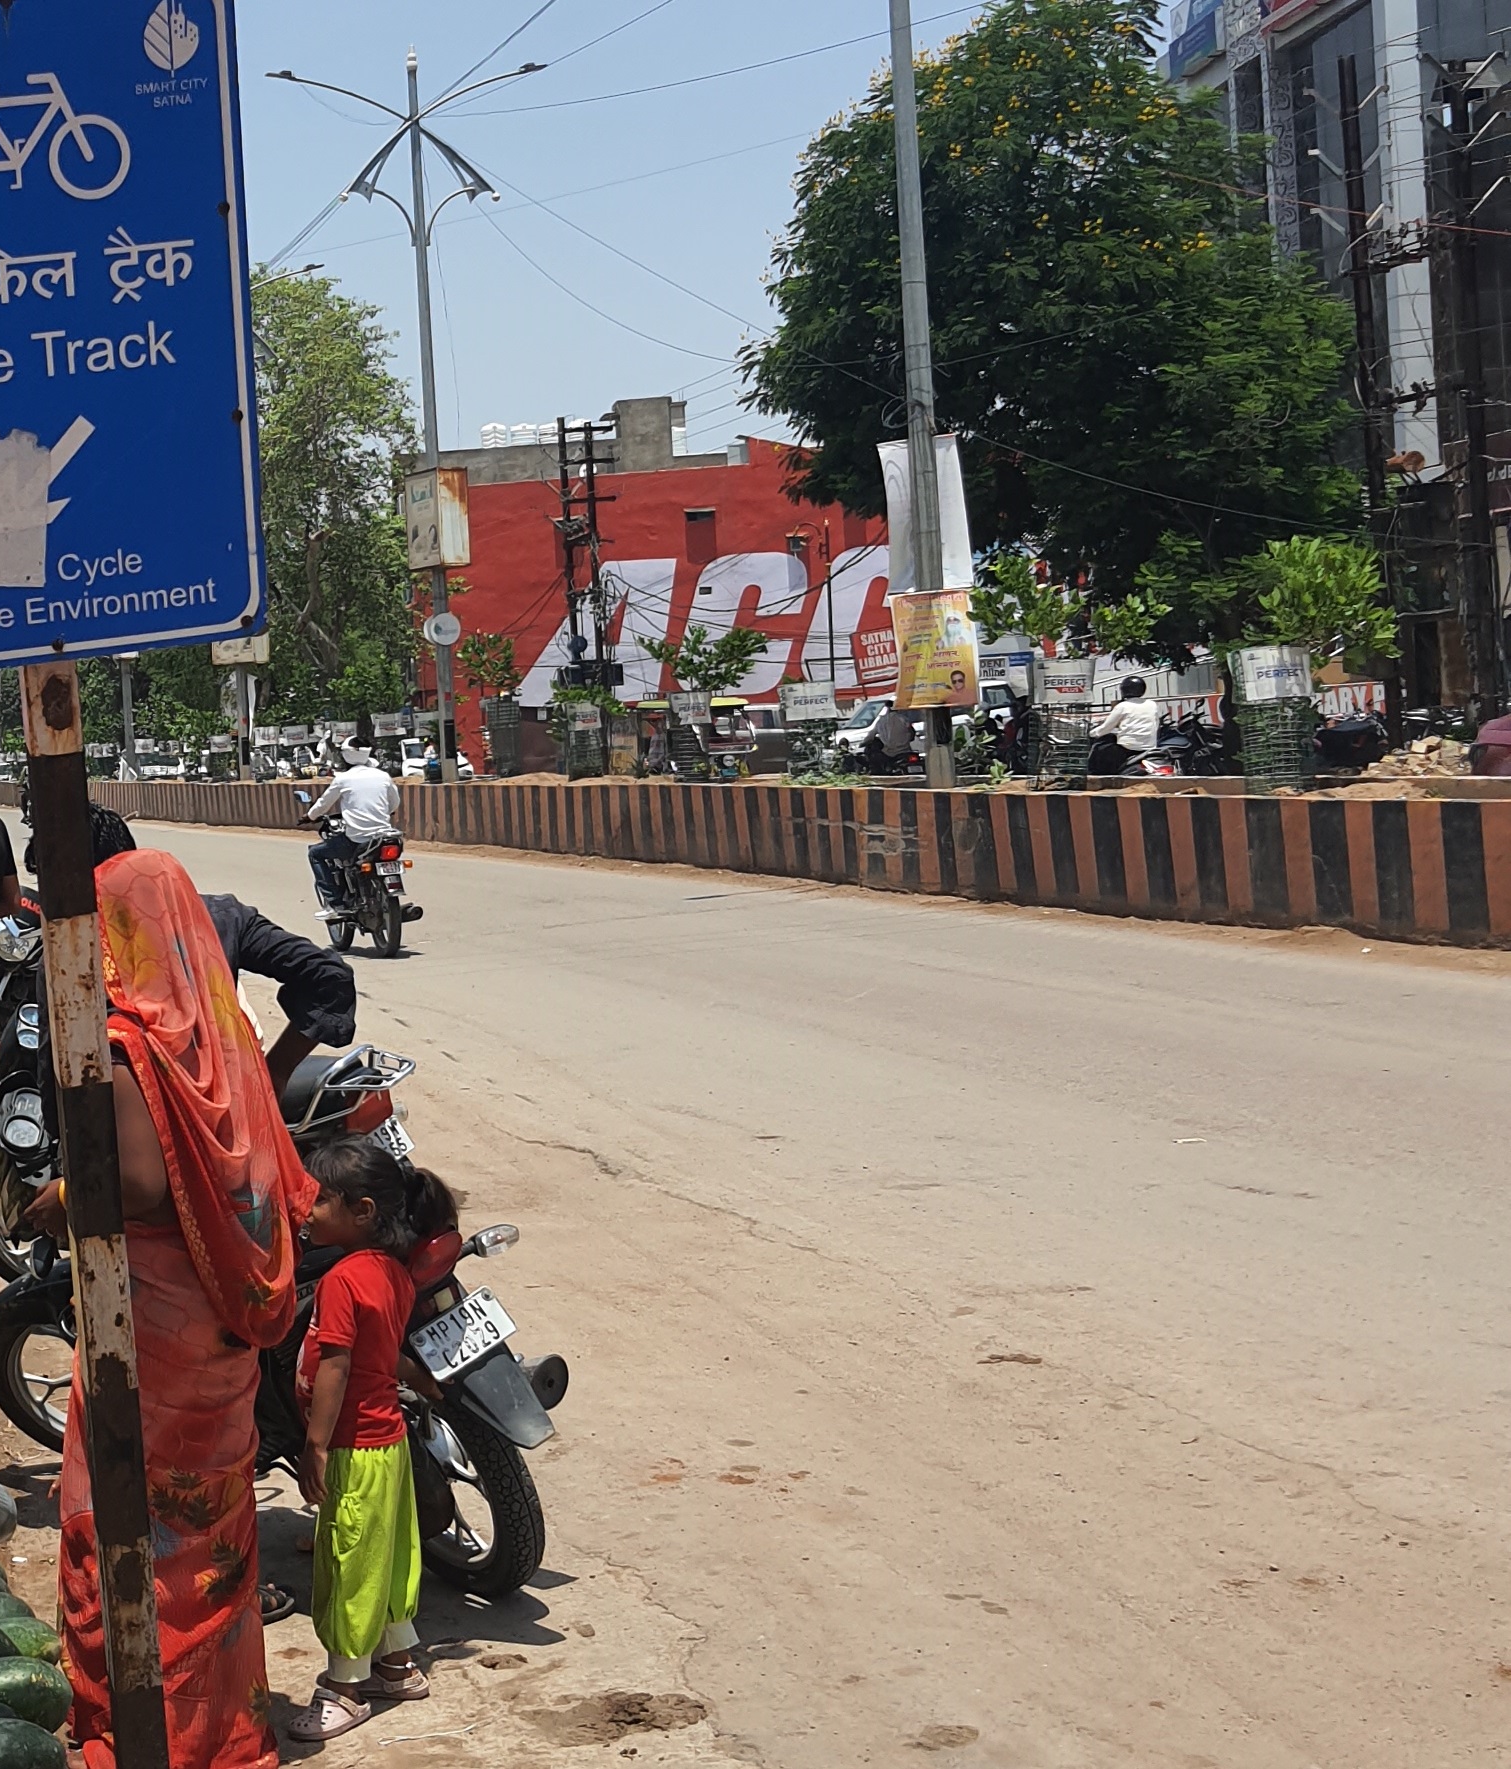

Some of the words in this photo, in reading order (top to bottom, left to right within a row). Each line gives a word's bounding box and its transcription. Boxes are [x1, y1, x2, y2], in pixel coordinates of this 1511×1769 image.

[135, 80, 176, 95] SMART
[180, 77, 208, 90] CITY
[153, 93, 192, 107] SATNA
[104, 226, 194, 304] ट्रैक
[31, 320, 177, 377] Track
[57, 548, 143, 586] Cycle
[25, 577, 217, 625] Environment
[860, 630, 894, 646] SATNA
[866, 642, 891, 656] CITY
[858, 653, 898, 669] LIBRAR
[20, 897, 41, 914] OLIC
[426, 1299, 487, 1342] MP19N
